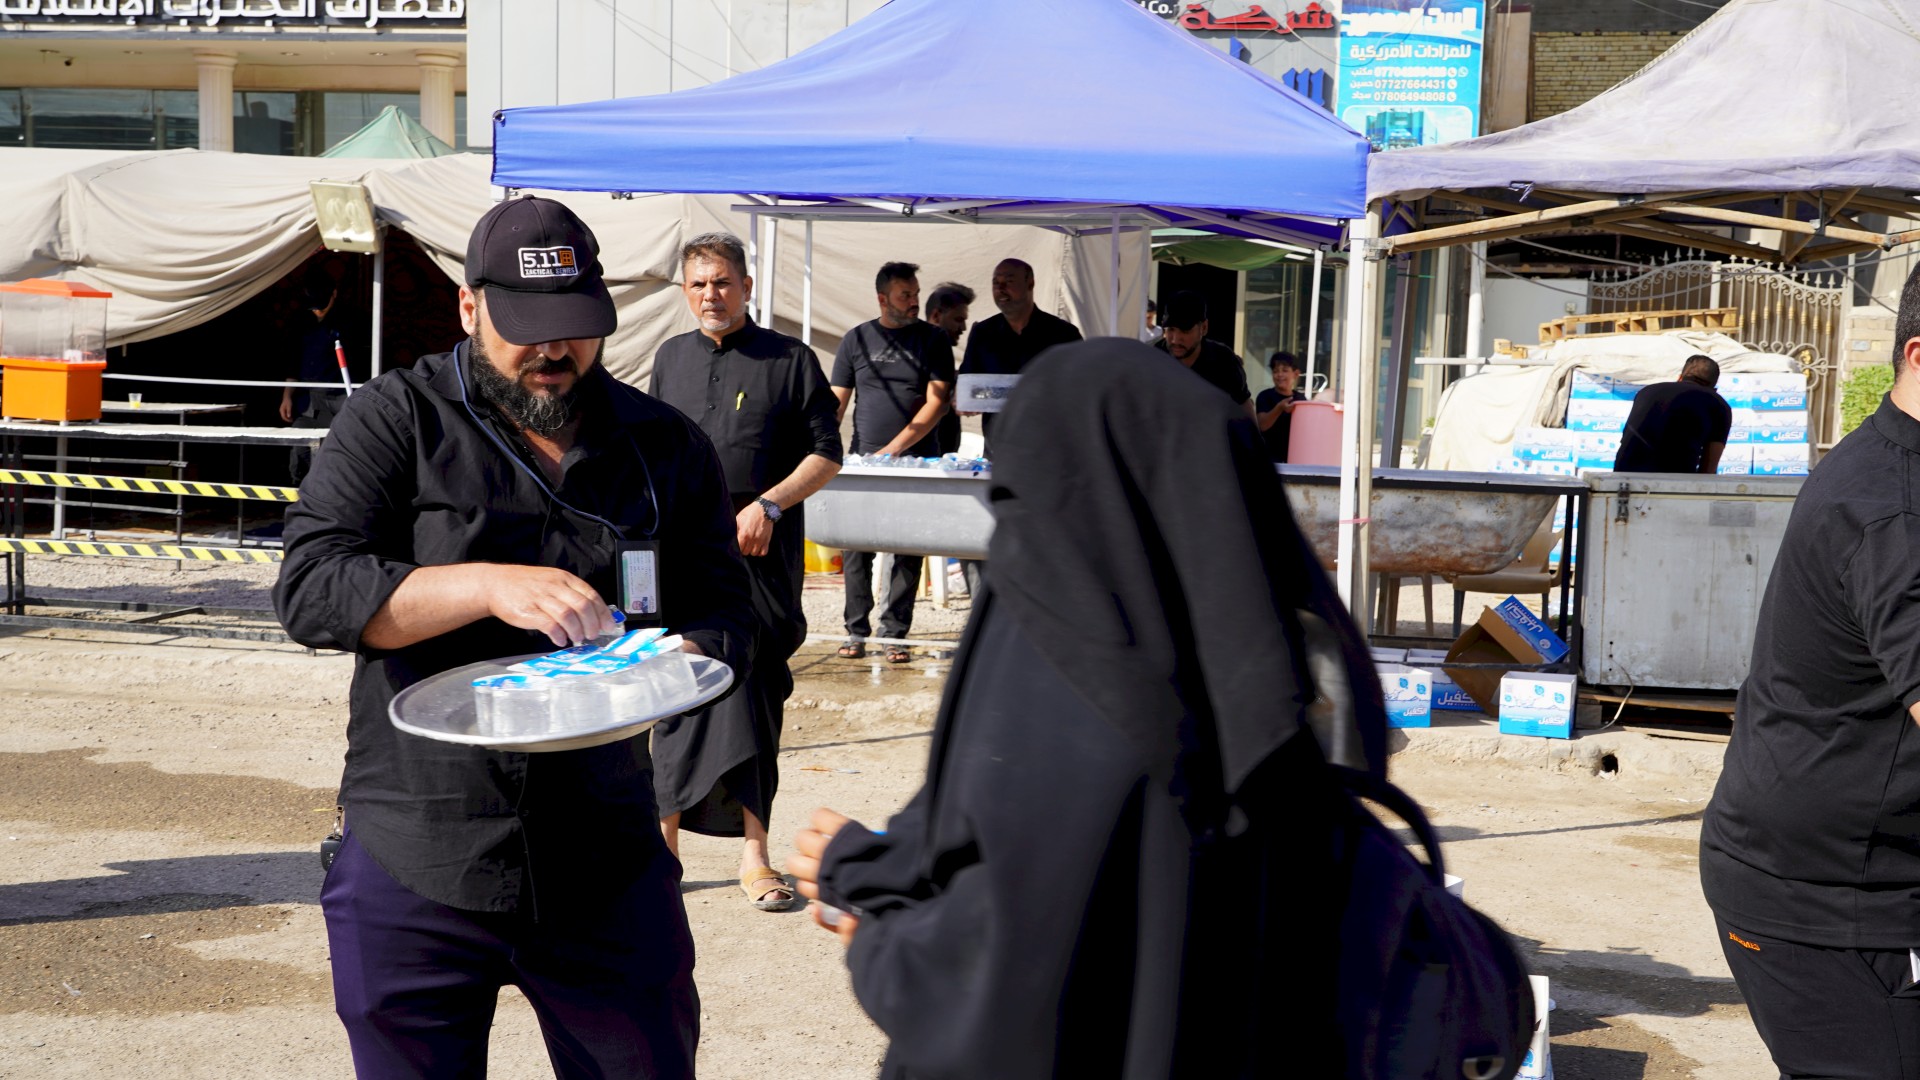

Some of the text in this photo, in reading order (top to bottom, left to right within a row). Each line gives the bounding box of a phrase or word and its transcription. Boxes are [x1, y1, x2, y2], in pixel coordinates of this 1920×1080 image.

[1179, 2, 1334, 35] شركة
[1414, 44, 1472, 61] للمزادات
[523, 251, 562, 268] 5.11
[525, 267, 575, 276] TACTICAL SERIES
[1437, 690, 1476, 705] كفيل
